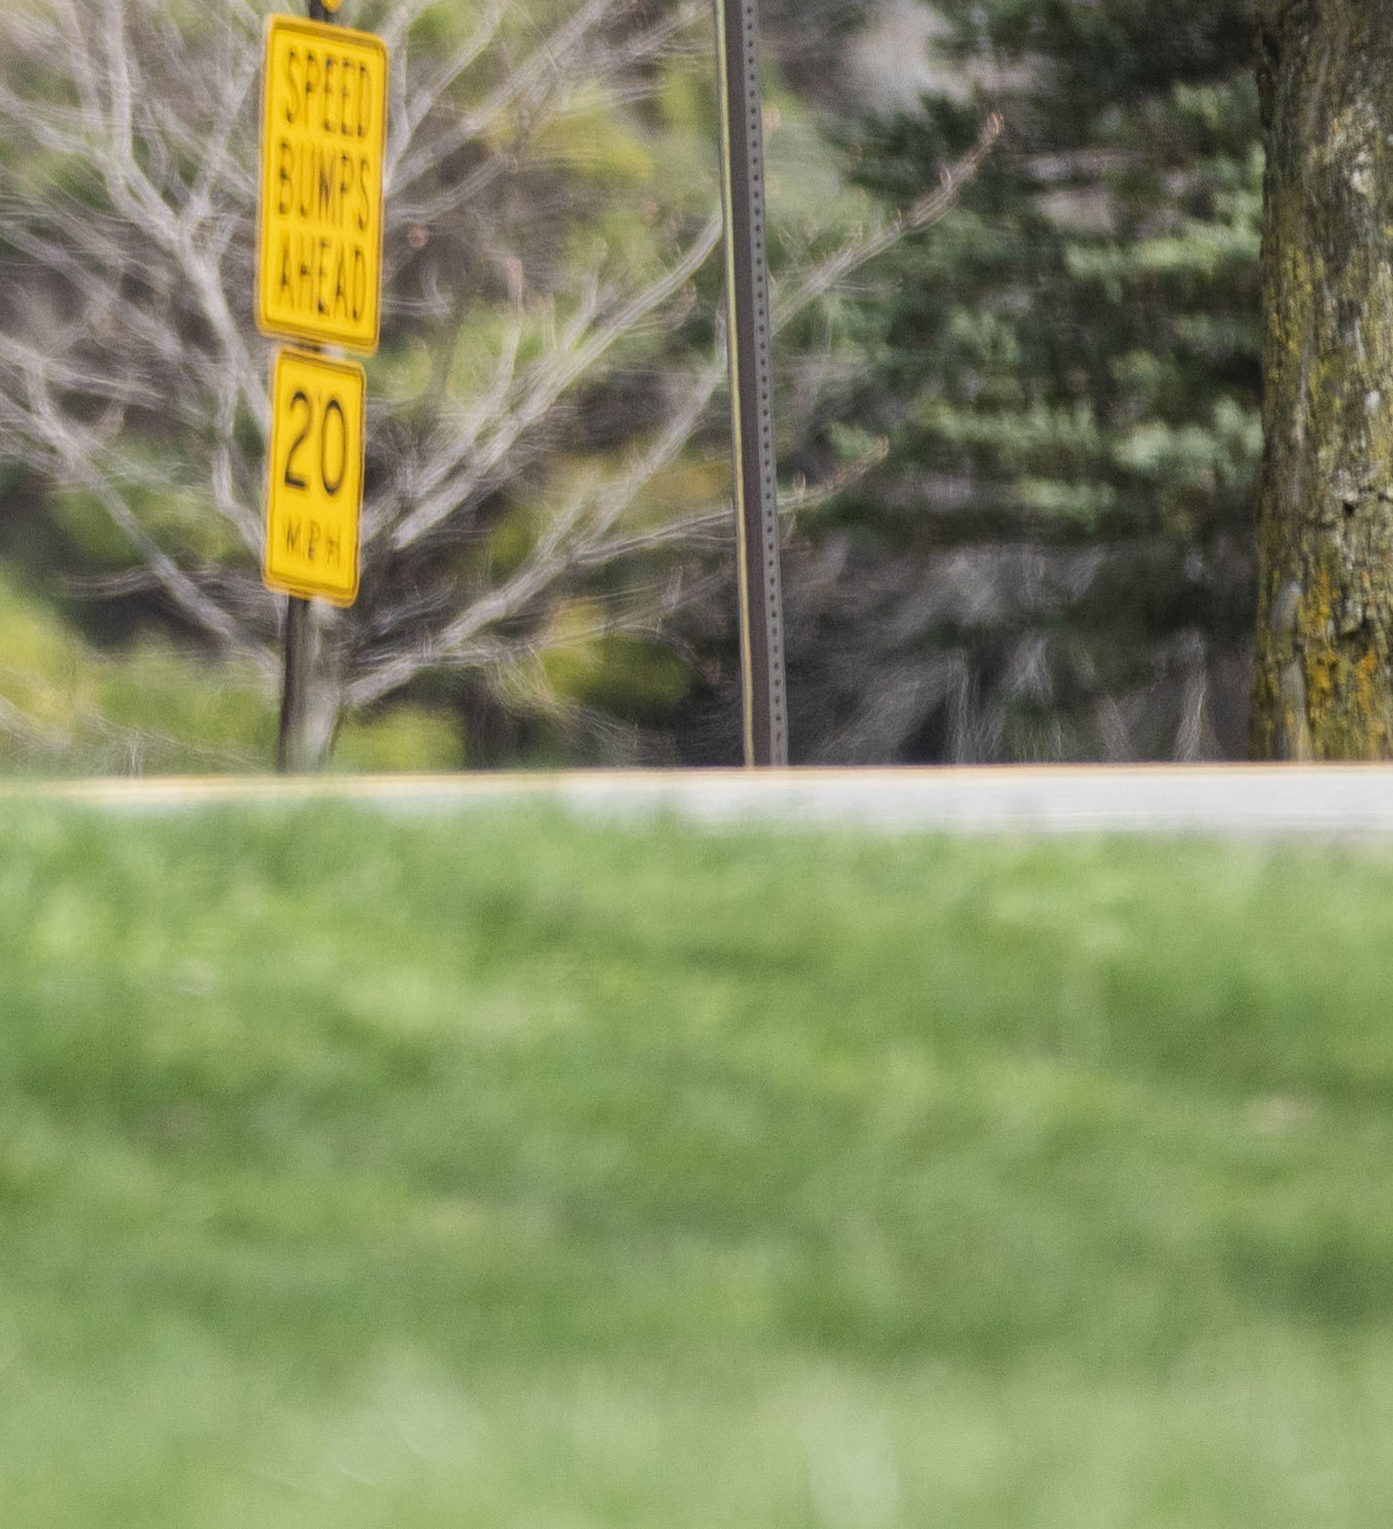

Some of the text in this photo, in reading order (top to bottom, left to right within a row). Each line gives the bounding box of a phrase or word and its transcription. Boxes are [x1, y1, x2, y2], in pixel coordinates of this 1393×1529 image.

[286, 47, 372, 139] SPEED
[278, 140, 370, 231] BUMPS
[278, 233, 366, 321] AHEAD
[284, 390, 346, 496] 20
[284, 515, 342, 568] MPH
